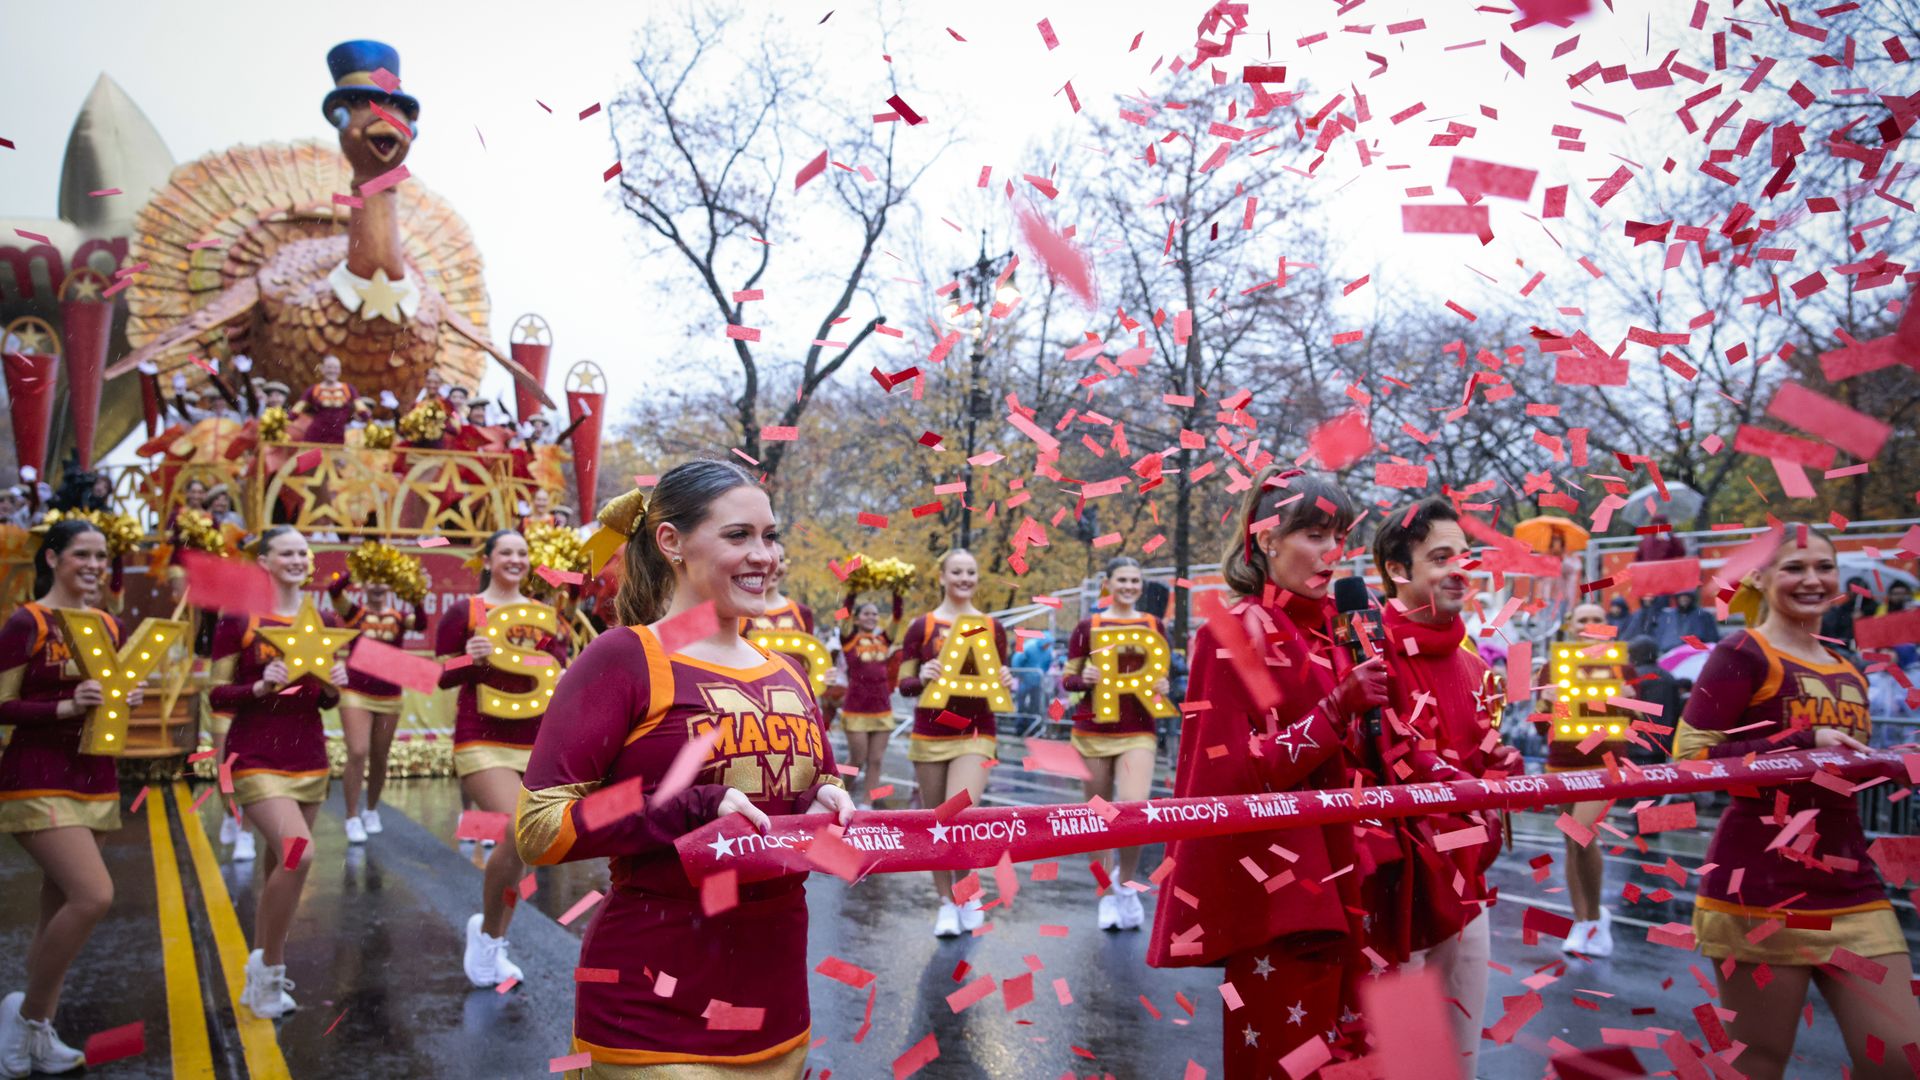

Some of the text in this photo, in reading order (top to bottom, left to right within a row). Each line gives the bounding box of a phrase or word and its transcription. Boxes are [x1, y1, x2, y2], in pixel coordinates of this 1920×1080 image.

[53, 608, 188, 756] Y
[476, 602, 561, 719] S
[917, 613, 1016, 713] A
[1090, 625, 1180, 723] R
[1552, 641, 1631, 741] E
[952, 811, 1027, 843] macy's
[1051, 815, 1109, 837] PARADE
[1248, 799, 1300, 818] PARADE
[1335, 786, 1395, 809] mcy's
